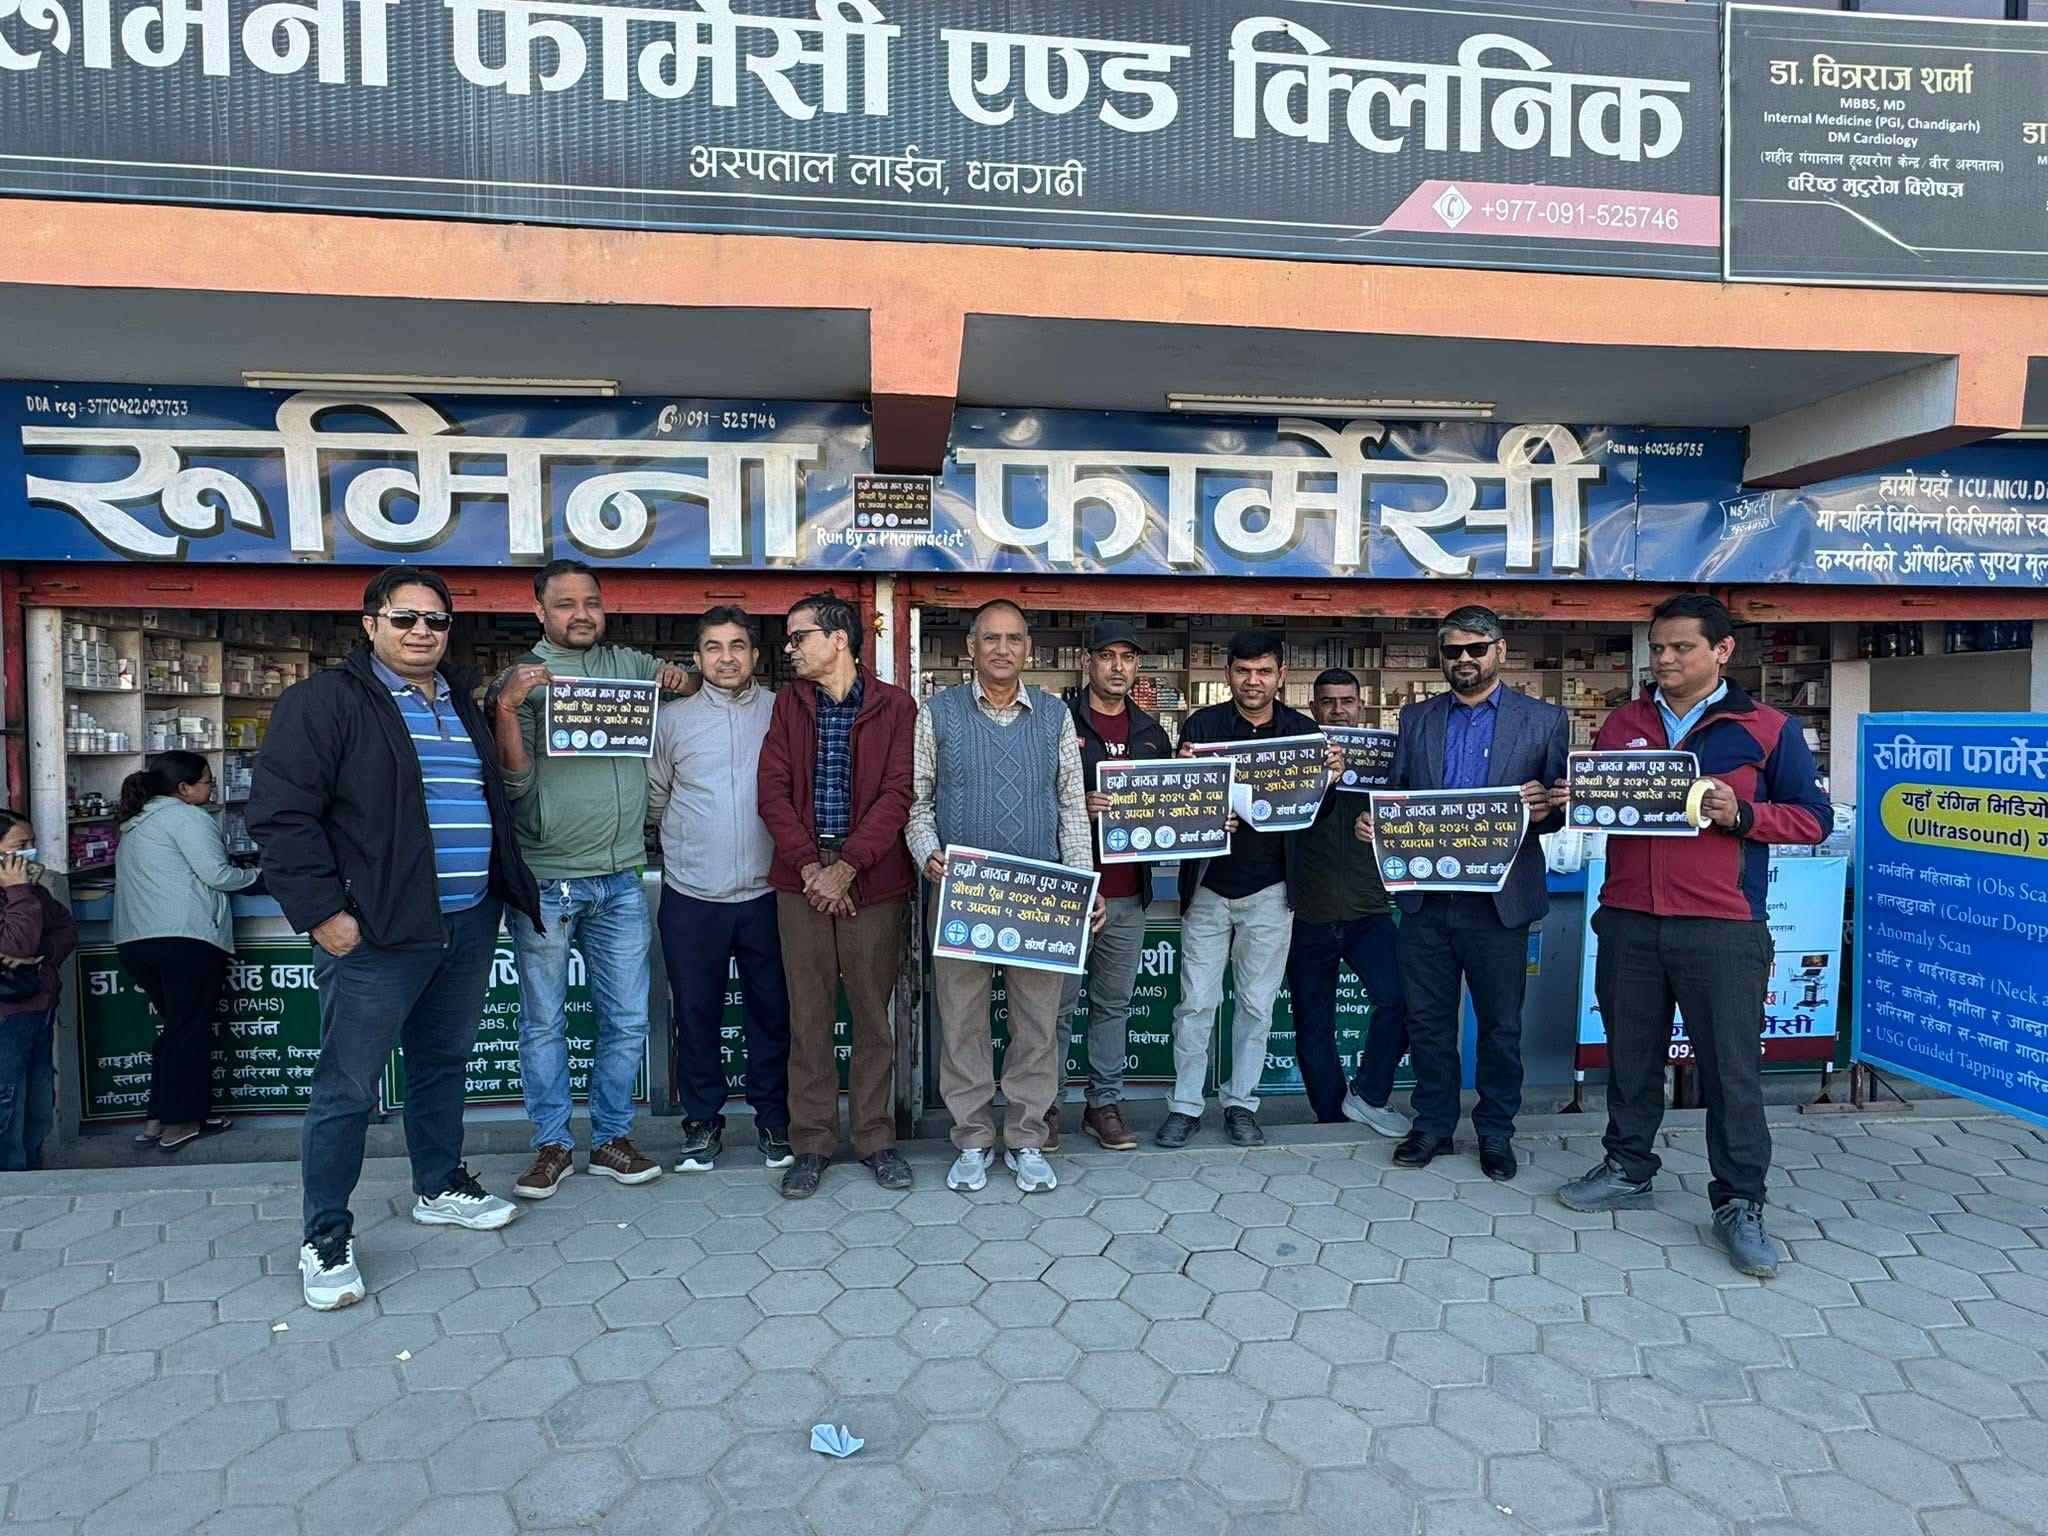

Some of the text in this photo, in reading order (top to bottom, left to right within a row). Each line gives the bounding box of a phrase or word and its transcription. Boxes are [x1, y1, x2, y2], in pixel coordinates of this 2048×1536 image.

[941, 28, 1190, 133] एण्ड
[1229, 17, 1689, 162] क्लिनिक
[1769, 54, 1974, 94] डा. चित्रराज शर्मा
[1840, 98, 1905, 112] MBBS, MD
[1764, 112, 1981, 133] Internal Medicine (PGI, Chandigarh)
[1829, 133, 1918, 147] DM Cardiology
[689, 143, 1087, 197] अस्पताल लाईन, धनगढी
[1799, 150, 1843, 166] गंगालाल
[1787, 172, 1964, 198] वरिष्ठ मुटुरोग विशेषज्ञ
[1482, 199, 1680, 230] +977-091-525746
[26, 396, 50, 412] DDA
[21, 391, 1599, 574] रूमिना फार्मेसी
[1920, 469, 1953, 502] यहाँ
[846, 528, 863, 549] By
[867, 533, 876, 546] a
[1815, 543, 1897, 573] कम्पनीको
[1980, 552, 2024, 581] सुपथ
[1873, 734, 1954, 772] रूमिना
[1902, 790, 1931, 811] यहाँ
[1936, 791, 1981, 813] रंगिन
[1908, 818, 2030, 853] (Ultrasound)
[953, 860, 977, 878] हाम्रो
[1014, 872, 1036, 886] माग
[1061, 880, 1079, 893] गर
[1920, 867, 1971, 889] महिलाको
[1977, 877, 2015, 898] (Obs
[1877, 922, 1972, 955] Anomaly Scan
[1941, 904, 1998, 929] (Colour
[2002, 914, 2048, 943] Dopp
[89, 971, 125, 995] डा.
[1991, 979, 2037, 1005] (Neck
[234, 998, 285, 1014] (PAHS)
[229, 1016, 280, 1038] सर्जन
[1128, 1030, 1170, 1045] विशेषज्ञ
[1877, 1026, 2014, 1088] USG Guided Tapping
